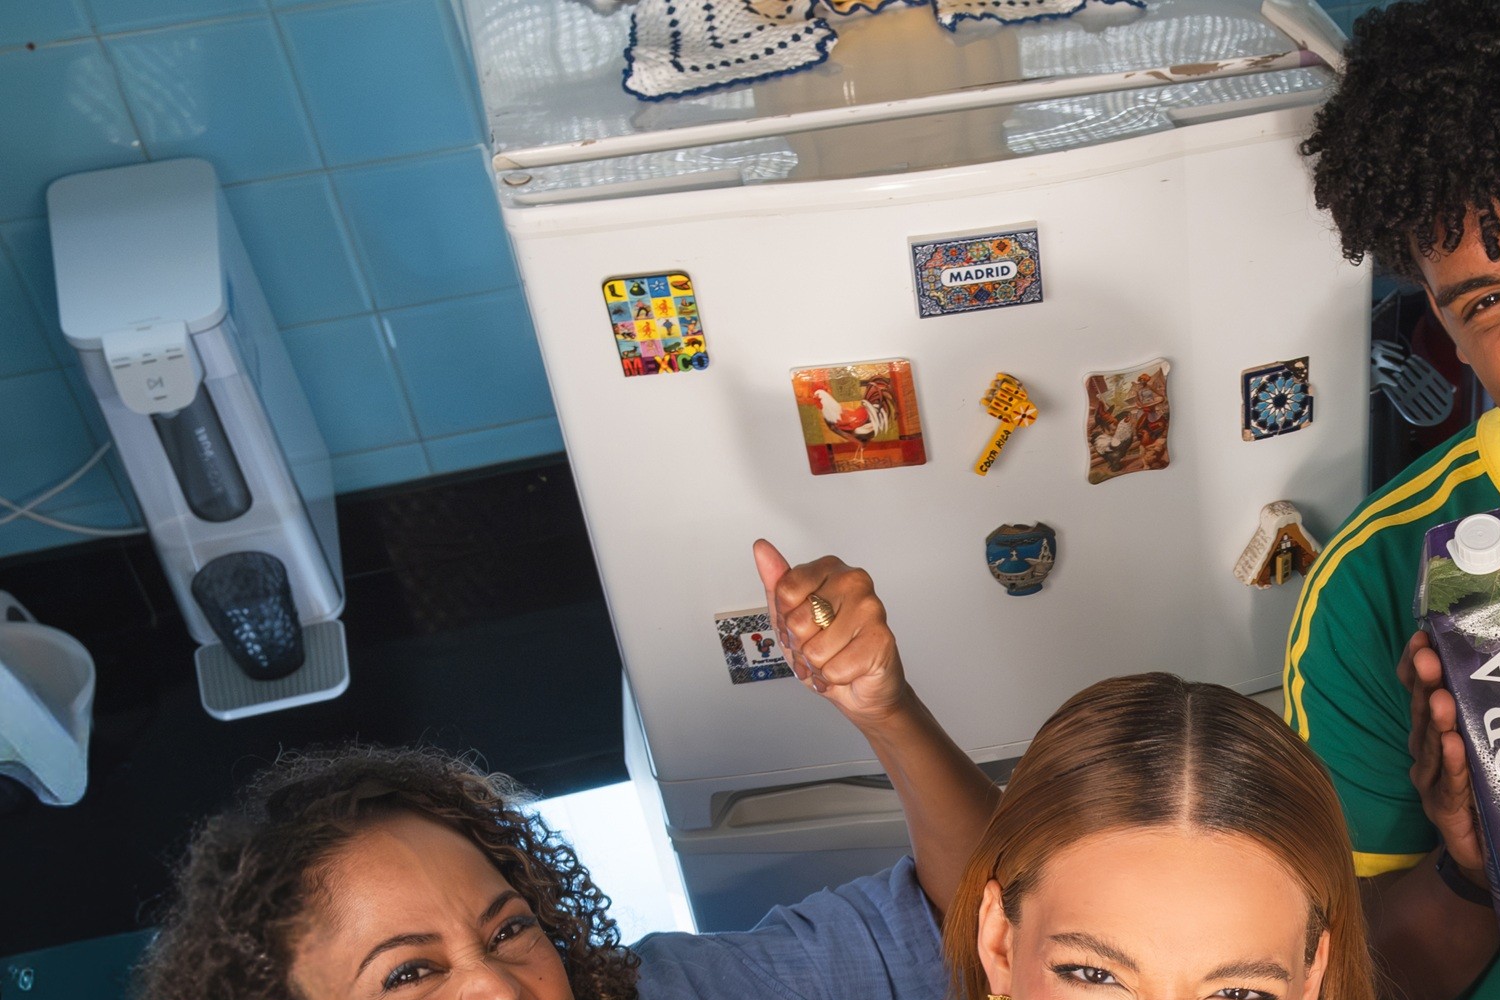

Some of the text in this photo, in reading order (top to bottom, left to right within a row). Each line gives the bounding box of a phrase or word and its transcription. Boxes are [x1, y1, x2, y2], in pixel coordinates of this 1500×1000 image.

[949, 265, 1011, 283] MADRID
[622, 352, 710, 377] MEXICO
[979, 429, 1012, 473] COSTA RICA
